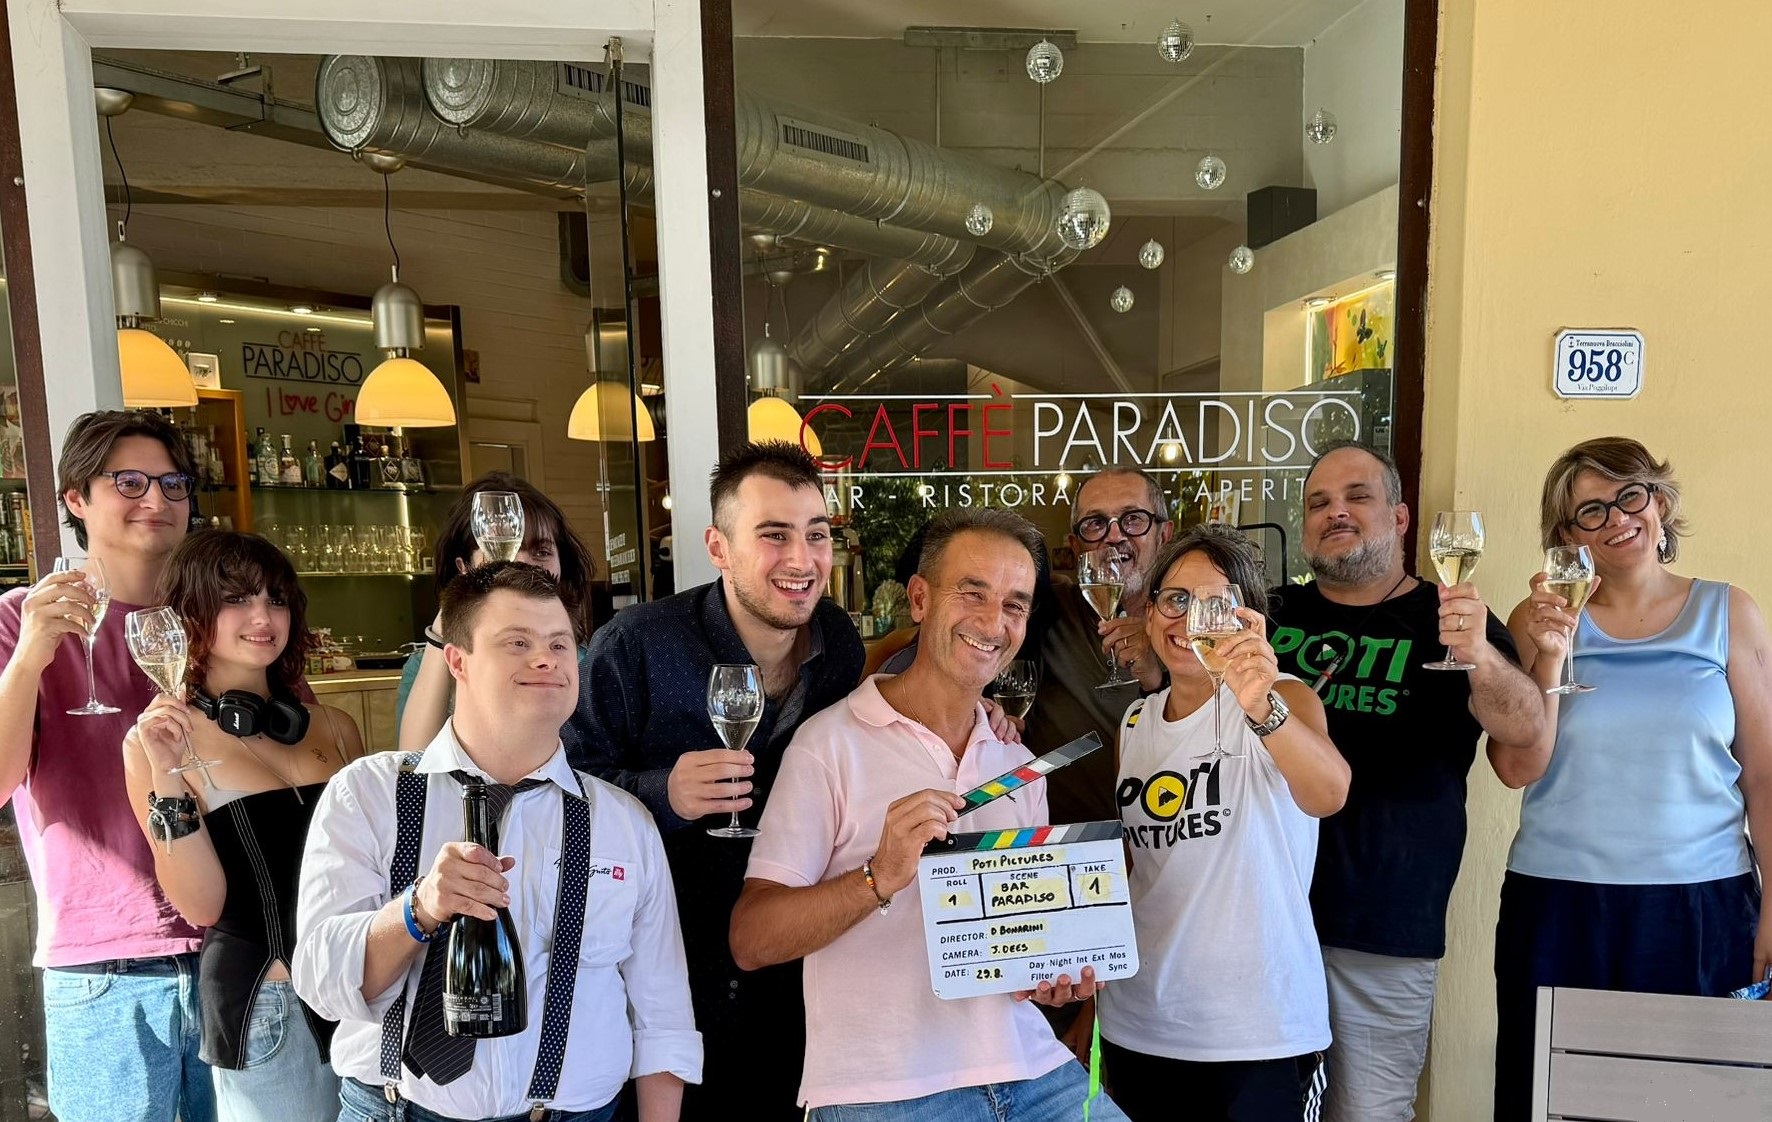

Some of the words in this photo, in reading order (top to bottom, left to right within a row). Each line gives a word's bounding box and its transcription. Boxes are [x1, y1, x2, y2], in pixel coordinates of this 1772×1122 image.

[242, 346, 363, 383] PARADISO
[800, 383, 1014, 469] CAFFÈ
[1034, 398, 1361, 467] PARADISO
[825, 485, 865, 509] AR
[922, 483, 1081, 508] RISTORA
[1194, 479, 1307, 503] APERIT
[1270, 626, 1412, 683] POTI
[1117, 758, 1221, 822] POTI
[931, 866, 958, 876] PROD.
[1085, 864, 1107, 873] TAKE
[1010, 872, 1039, 881] SCENE
[946, 879, 968, 887] ROLL
[1001, 882, 1030, 892] BAR
[1089, 877, 1101, 895] 1
[948, 894, 957, 906] 1
[992, 892, 1055, 907] PARADISO
[1000, 923, 1044, 935] BONARINI
[940, 932, 988, 944] DIRECTOR:
[942, 950, 983, 961] CAMERA:
[1076, 955, 1088, 964] Int
[1092, 954, 1105, 963] Ext
[1109, 952, 1126, 961] Mos
[1108, 962, 1128, 973] Sync
[944, 969, 970, 979] DATE:
[1030, 972, 1054, 982] Filter
